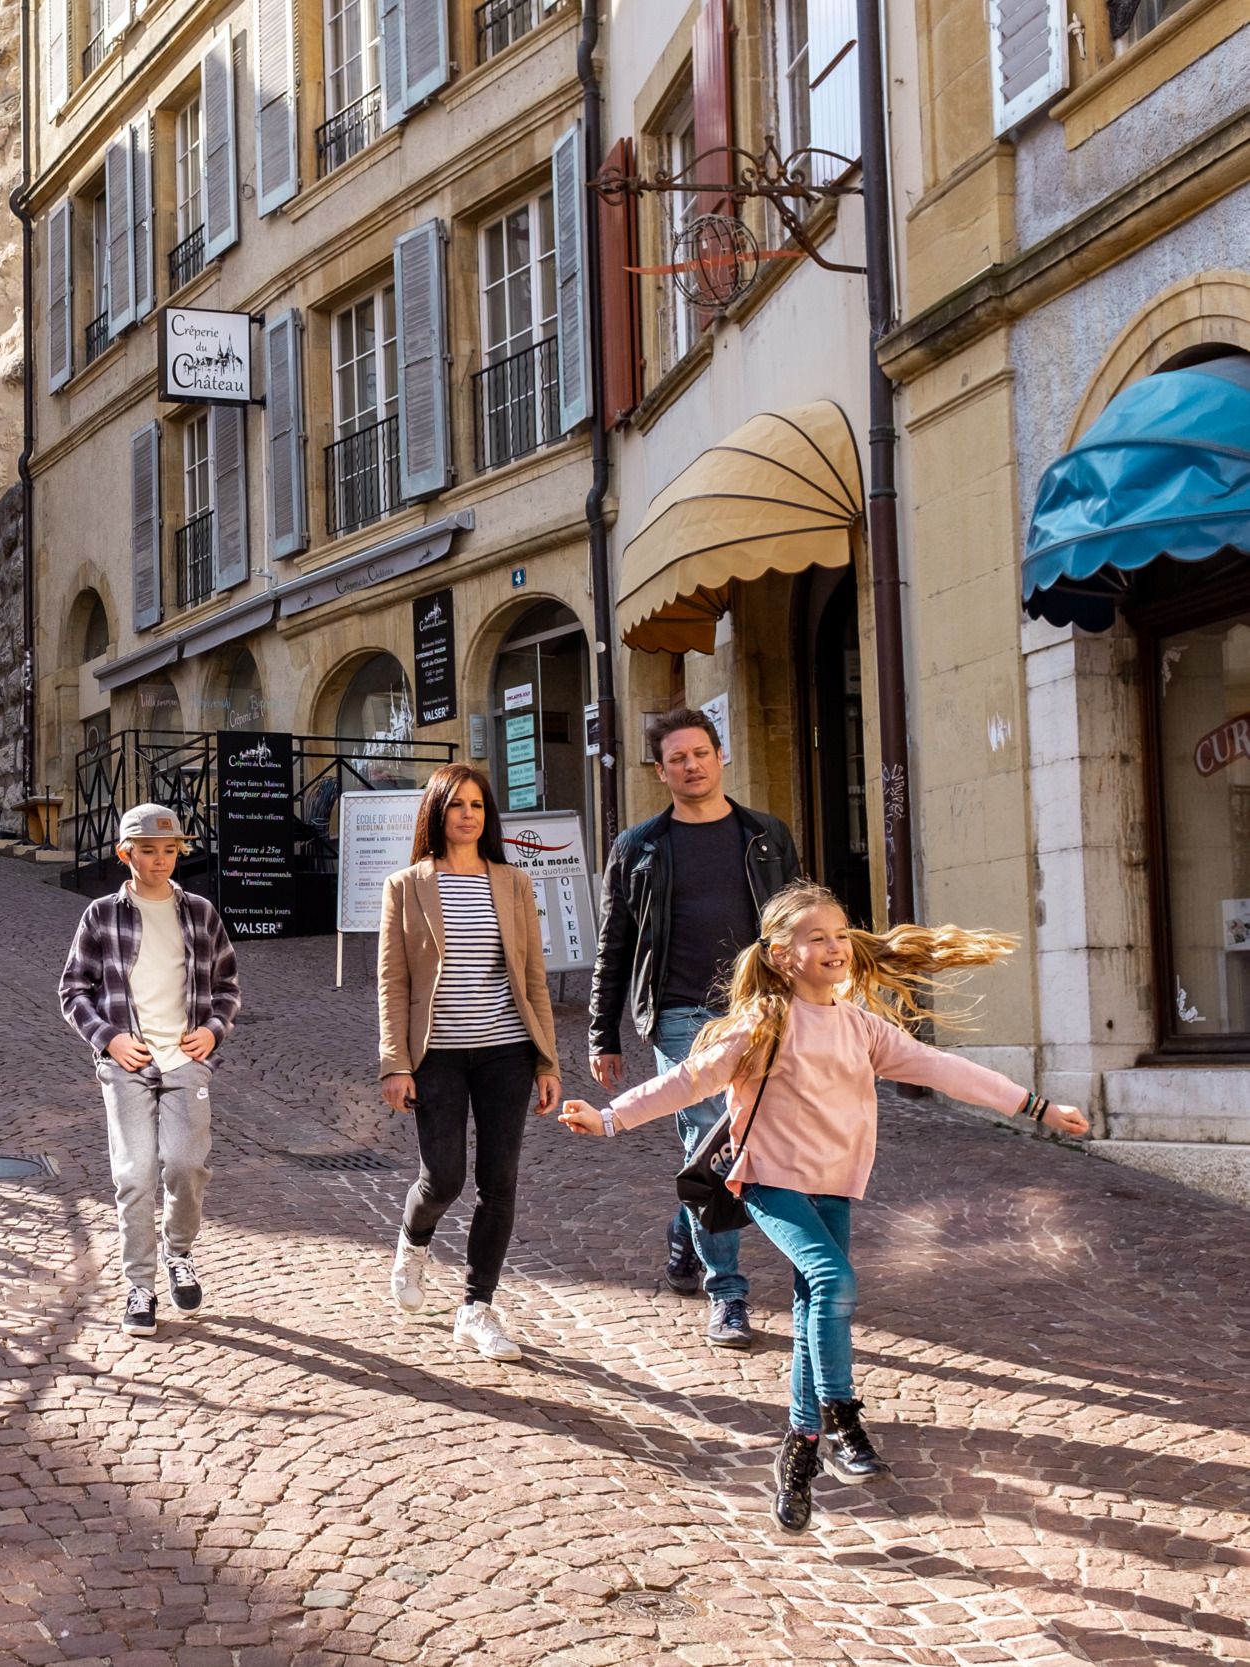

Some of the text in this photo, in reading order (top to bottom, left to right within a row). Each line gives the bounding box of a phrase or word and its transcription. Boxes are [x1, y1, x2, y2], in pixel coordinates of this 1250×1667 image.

[171, 314, 219, 340] Crêperie
[195, 341, 207, 352] du
[172, 353, 245, 392] Château
[515, 571, 522, 585] 4
[422, 706, 447, 721] VALSER
[225, 779, 246, 788] Crêpes
[228, 812, 245, 820] Petite
[264, 813, 284, 821] offerte
[378, 815, 388, 824] DE
[388, 814, 413, 823] VIOLON
[233, 845, 259, 854] Terrasse
[532, 858, 544, 867] du
[547, 856, 580, 866] monde
[542, 867, 581, 876] quotidien
[224, 906, 248, 914] Ouvert
[264, 907, 273, 915] les
[274, 907, 291, 916] jours
[560, 877, 580, 960] OUVERT
[233, 922, 277, 934] VALSER
